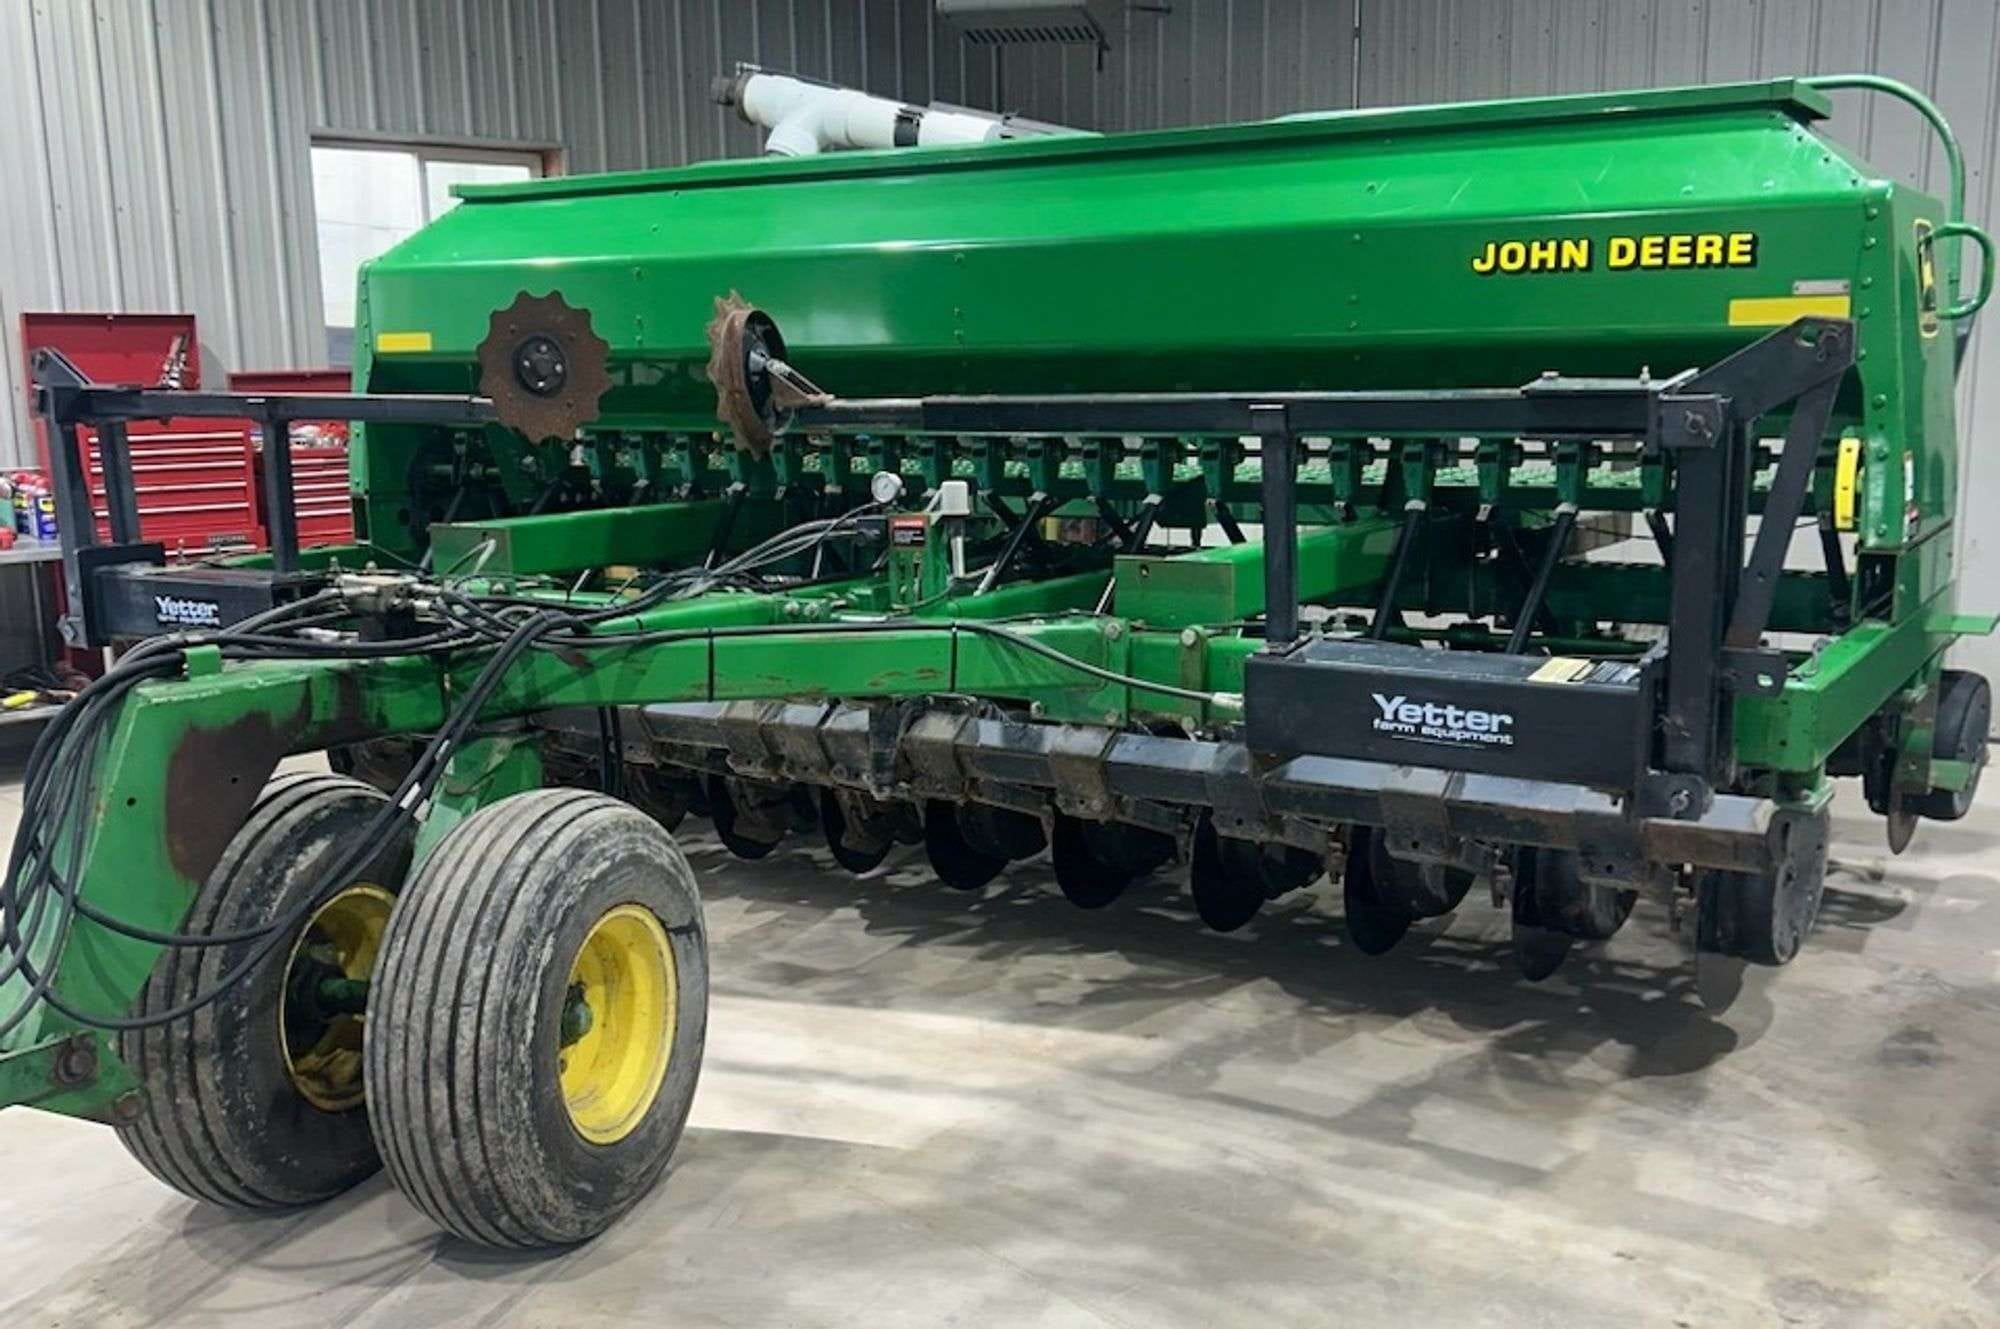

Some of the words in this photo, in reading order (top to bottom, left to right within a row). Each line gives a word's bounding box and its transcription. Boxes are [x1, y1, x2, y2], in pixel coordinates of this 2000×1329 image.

[1472, 239, 1591, 273] JOHN
[1607, 233, 1756, 268] DEERE
[155, 596, 219, 617] Yetter
[1371, 693, 1514, 733] Yetter
[1372, 718, 1416, 733] farm
[1420, 724, 1514, 745] equipment
